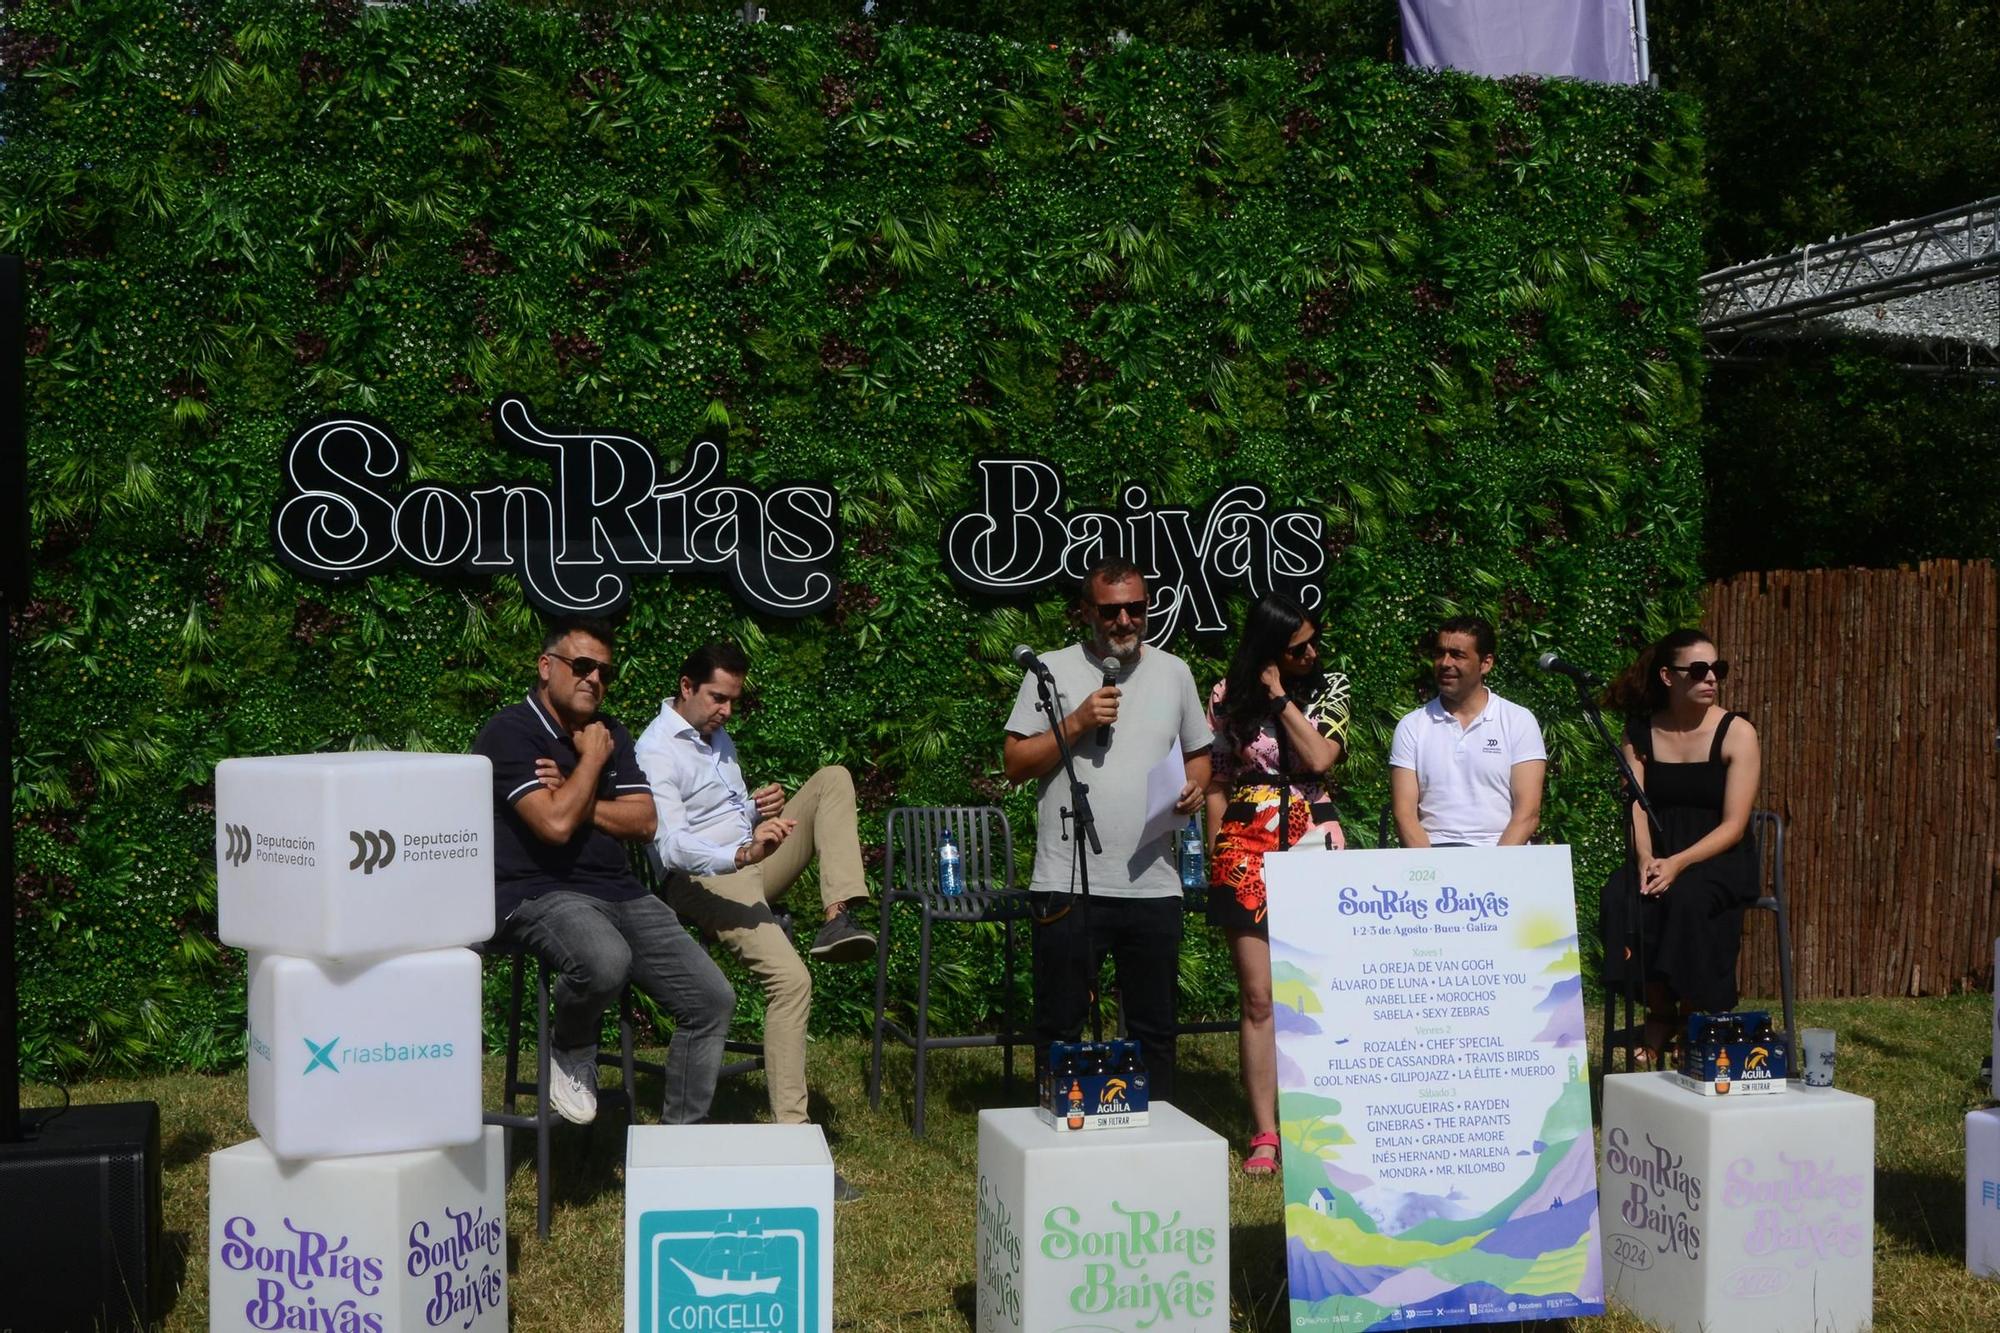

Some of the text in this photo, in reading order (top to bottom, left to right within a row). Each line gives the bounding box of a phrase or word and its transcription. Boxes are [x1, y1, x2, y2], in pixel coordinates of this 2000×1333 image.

[277, 399, 1325, 648] SonRías Baixas
[256, 834, 315, 851] Deputación
[404, 829, 478, 849] Deputación
[256, 850, 315, 867] Pontevedra
[404, 846, 478, 862] Pontevedra
[1409, 870, 1436, 881] 2024
[1338, 885, 1509, 921] SonRías Baixas
[1379, 926, 1391, 935] de
[1393, 925, 1428, 937] Agosto
[1435, 924, 1460, 933] Bueu
[1466, 923, 1498, 932] Galiza
[1363, 959, 1494, 974] LA OREJA DE VAN GOGH
[1331, 973, 1527, 991] ÁLVARO DE LUNA LA LA LOVE YOU
[1365, 991, 1496, 1006] ANABEL LEE MOROCHOS
[1374, 1006, 1490, 1020] SABELA SEXY ZEBRAS
[1416, 1026, 1444, 1035] Venres
[342, 1042, 454, 1064] riasbaixas
[1364, 1038, 1416, 1052] ROZALÉN
[1329, 1050, 1540, 1070] FILLAS DE CASSANDRA TRAVIS BIRDS
[1314, 1065, 1555, 1086] COOL NENAS GILIPOJAZZ LA ÉLITE MUERDO
[1419, 1089, 1447, 1098] Sábado
[1752, 1082, 1770, 1090] FILTRAR
[1366, 1099, 1510, 1116] TANXUGUEIRAS RAYDEN
[1098, 1117, 1130, 1126] SIN FILTRAR
[1367, 1114, 1511, 1132] GINEBRAS THE RAPANTS
[1376, 1131, 1505, 1148] EMLAN GRANDE AMORE
[1372, 1146, 1510, 1163] INÉS HERNAND MARLENA
[1379, 1162, 1505, 1179] MONDRA MR. KILOMBO
[1607, 1128, 1701, 1210] SonRías
[1723, 1151, 1864, 1213] SonRías
[1623, 1182, 1700, 1260] Baixas
[407, 1206, 500, 1277] SonRías
[1040, 1200, 1216, 1268] SonRías
[1743, 1210, 1863, 1268] Baixas
[221, 1216, 383, 1296] SonRías
[1614, 1238, 1646, 1267] 2024
[983, 1238, 1019, 1326] Baixas
[246, 1278, 383, 1333] Baixas
[426, 1264, 501, 1329] Baixas
[1070, 1263, 1215, 1329] Baixas
[668, 1303, 784, 1329] CONCELLO
